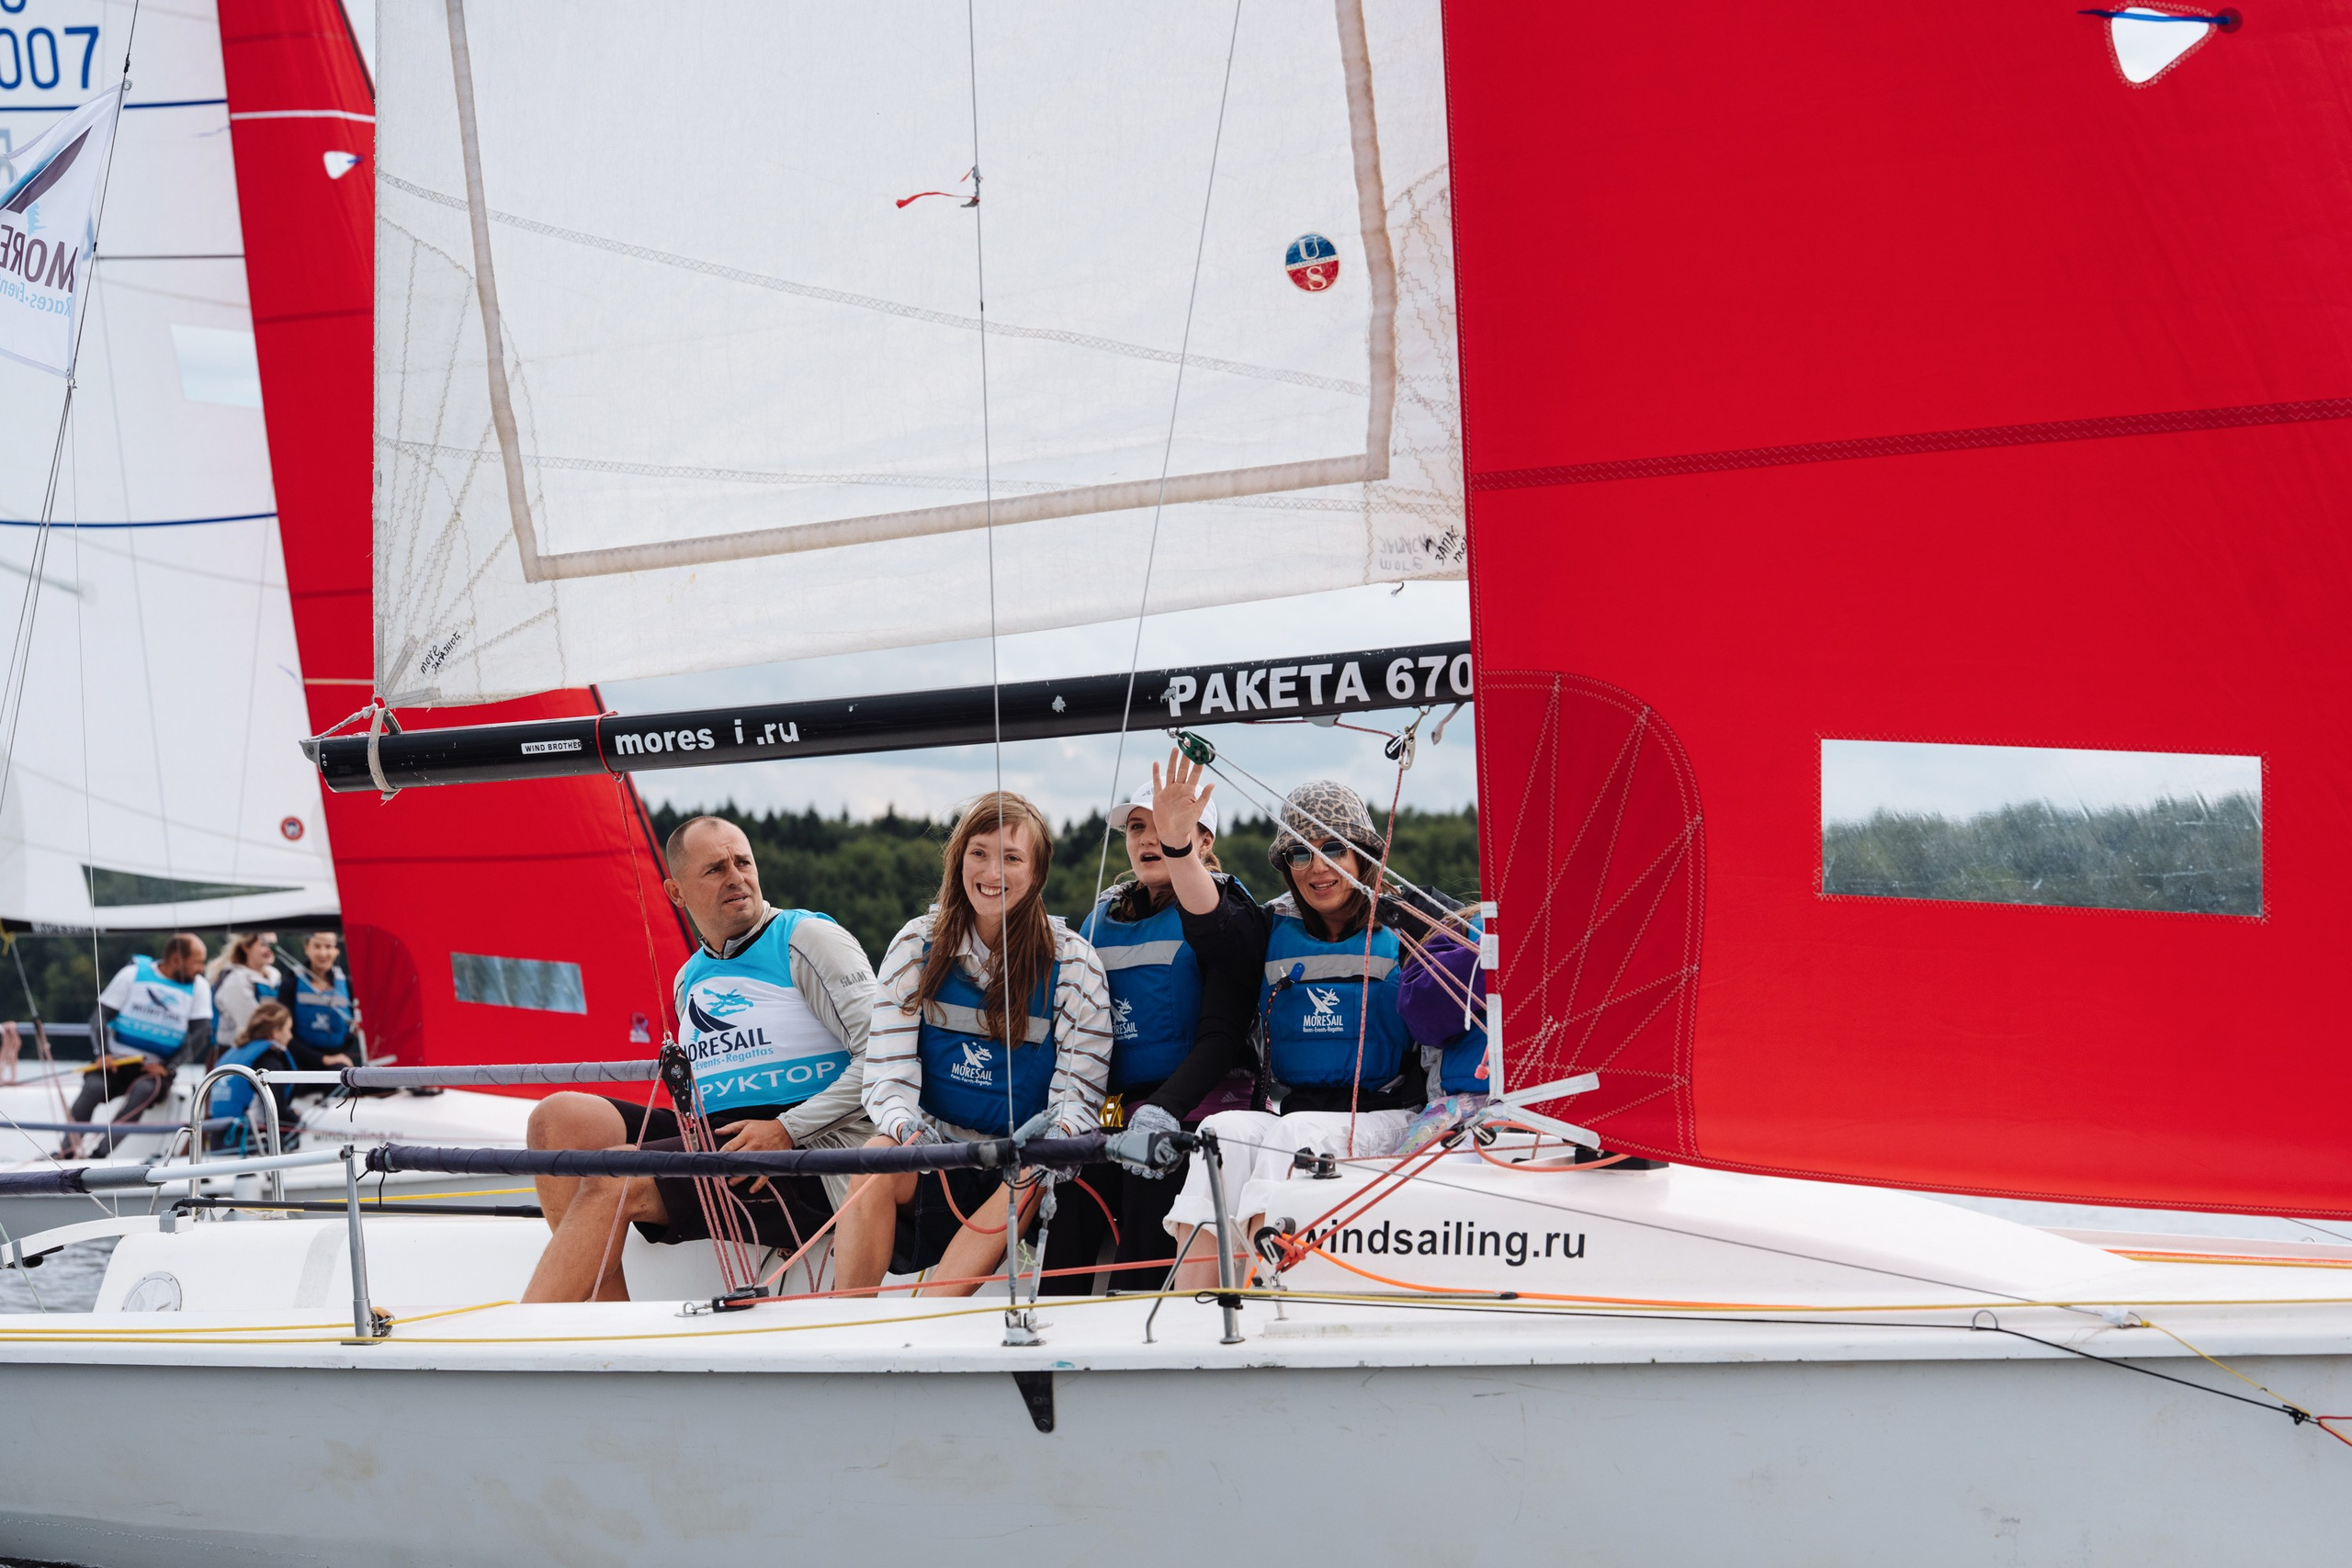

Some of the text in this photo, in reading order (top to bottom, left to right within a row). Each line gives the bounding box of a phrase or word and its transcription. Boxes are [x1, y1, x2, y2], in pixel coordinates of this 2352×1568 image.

[1385, 653, 1474, 700] 670
[525, 744, 546, 752] WIND
[1112, 1021, 1138, 1035] ORESAIL
[1303, 1014, 1343, 1027] MORESAIL
[684, 1027, 772, 1063] ORESAIL
[951, 1062, 992, 1081] MORESAIL
[691, 1061, 836, 1103] РУКТОР
